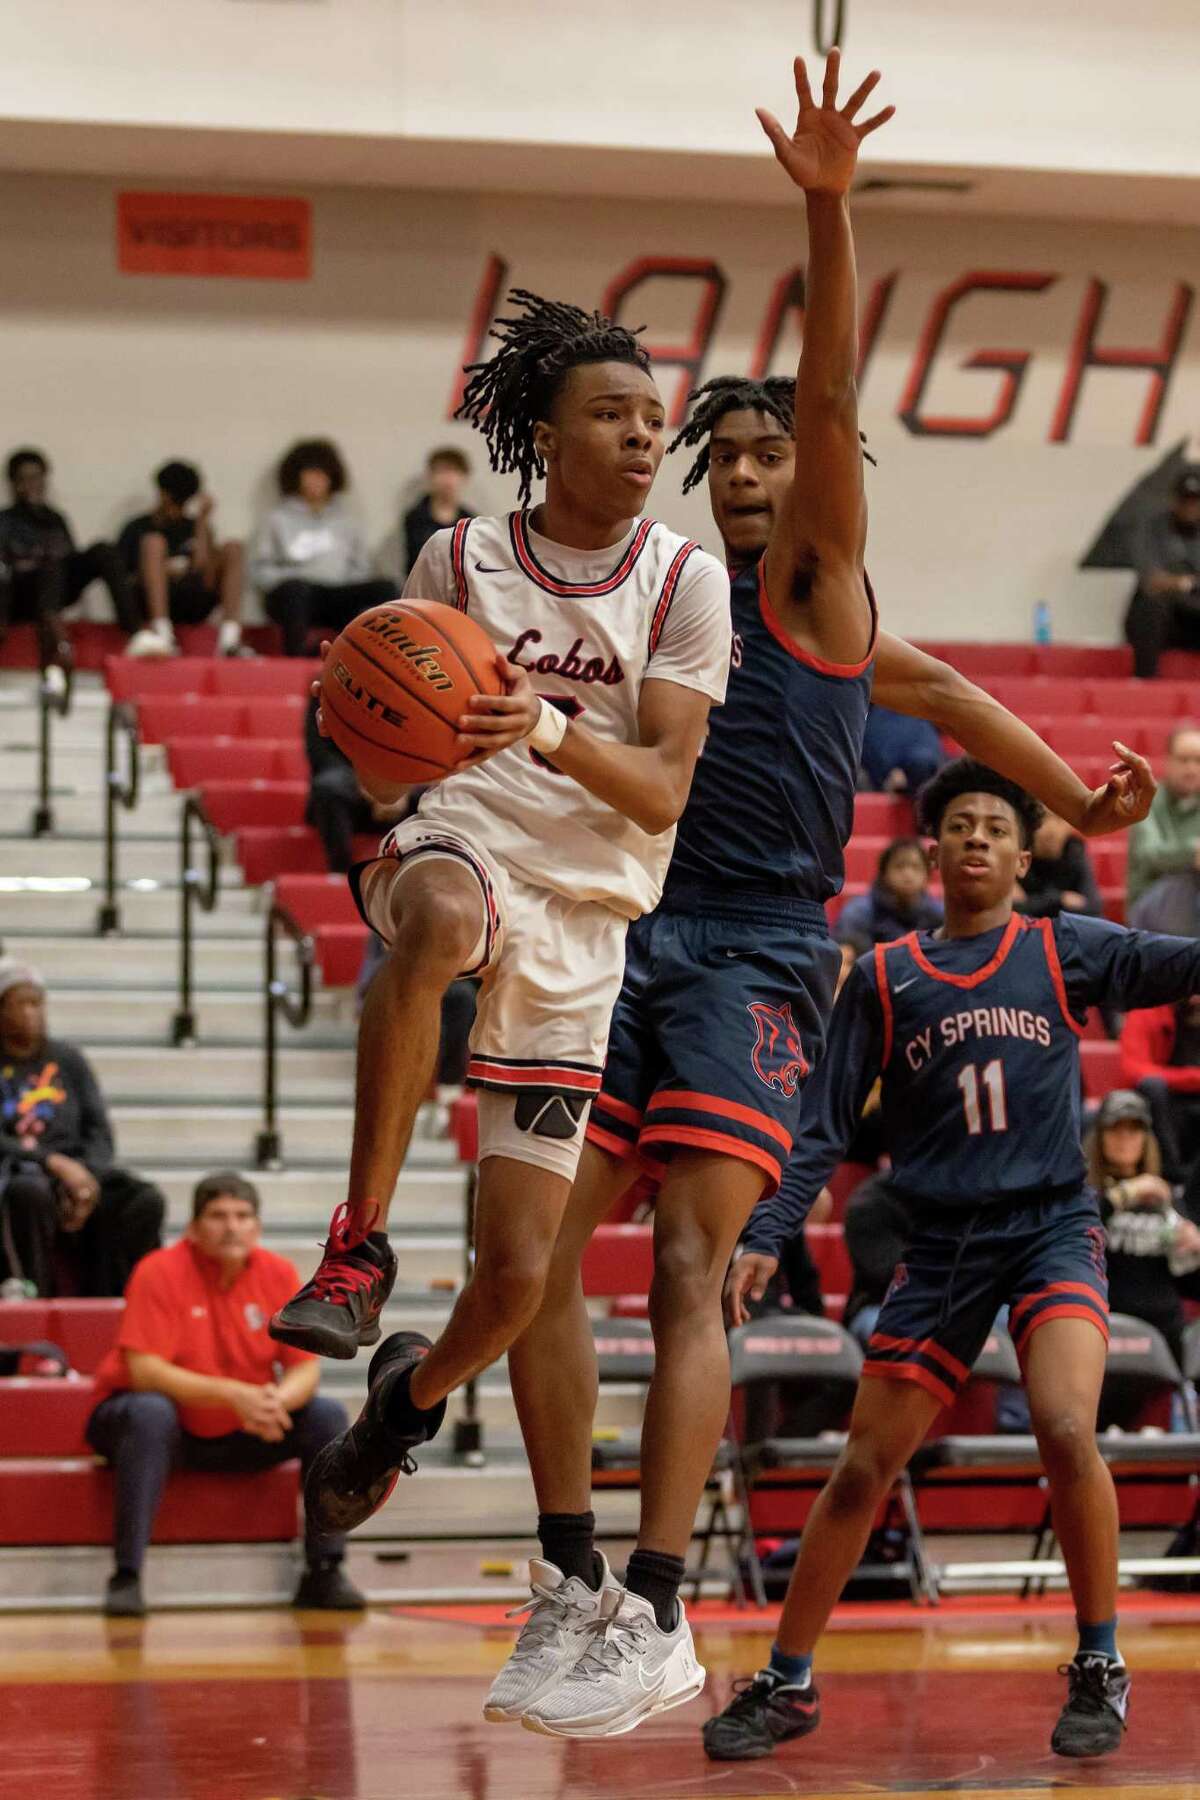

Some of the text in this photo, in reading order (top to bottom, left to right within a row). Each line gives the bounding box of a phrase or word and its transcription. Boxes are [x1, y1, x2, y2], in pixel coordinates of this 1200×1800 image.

[129, 214, 302, 252] VISITORS
[362, 612, 455, 692] Baden
[506, 628, 626, 686] Lobos
[332, 659, 410, 730] ELITE
[905, 1006, 1051, 1072] CY SPRINGS
[956, 1057, 1008, 1136] 11
